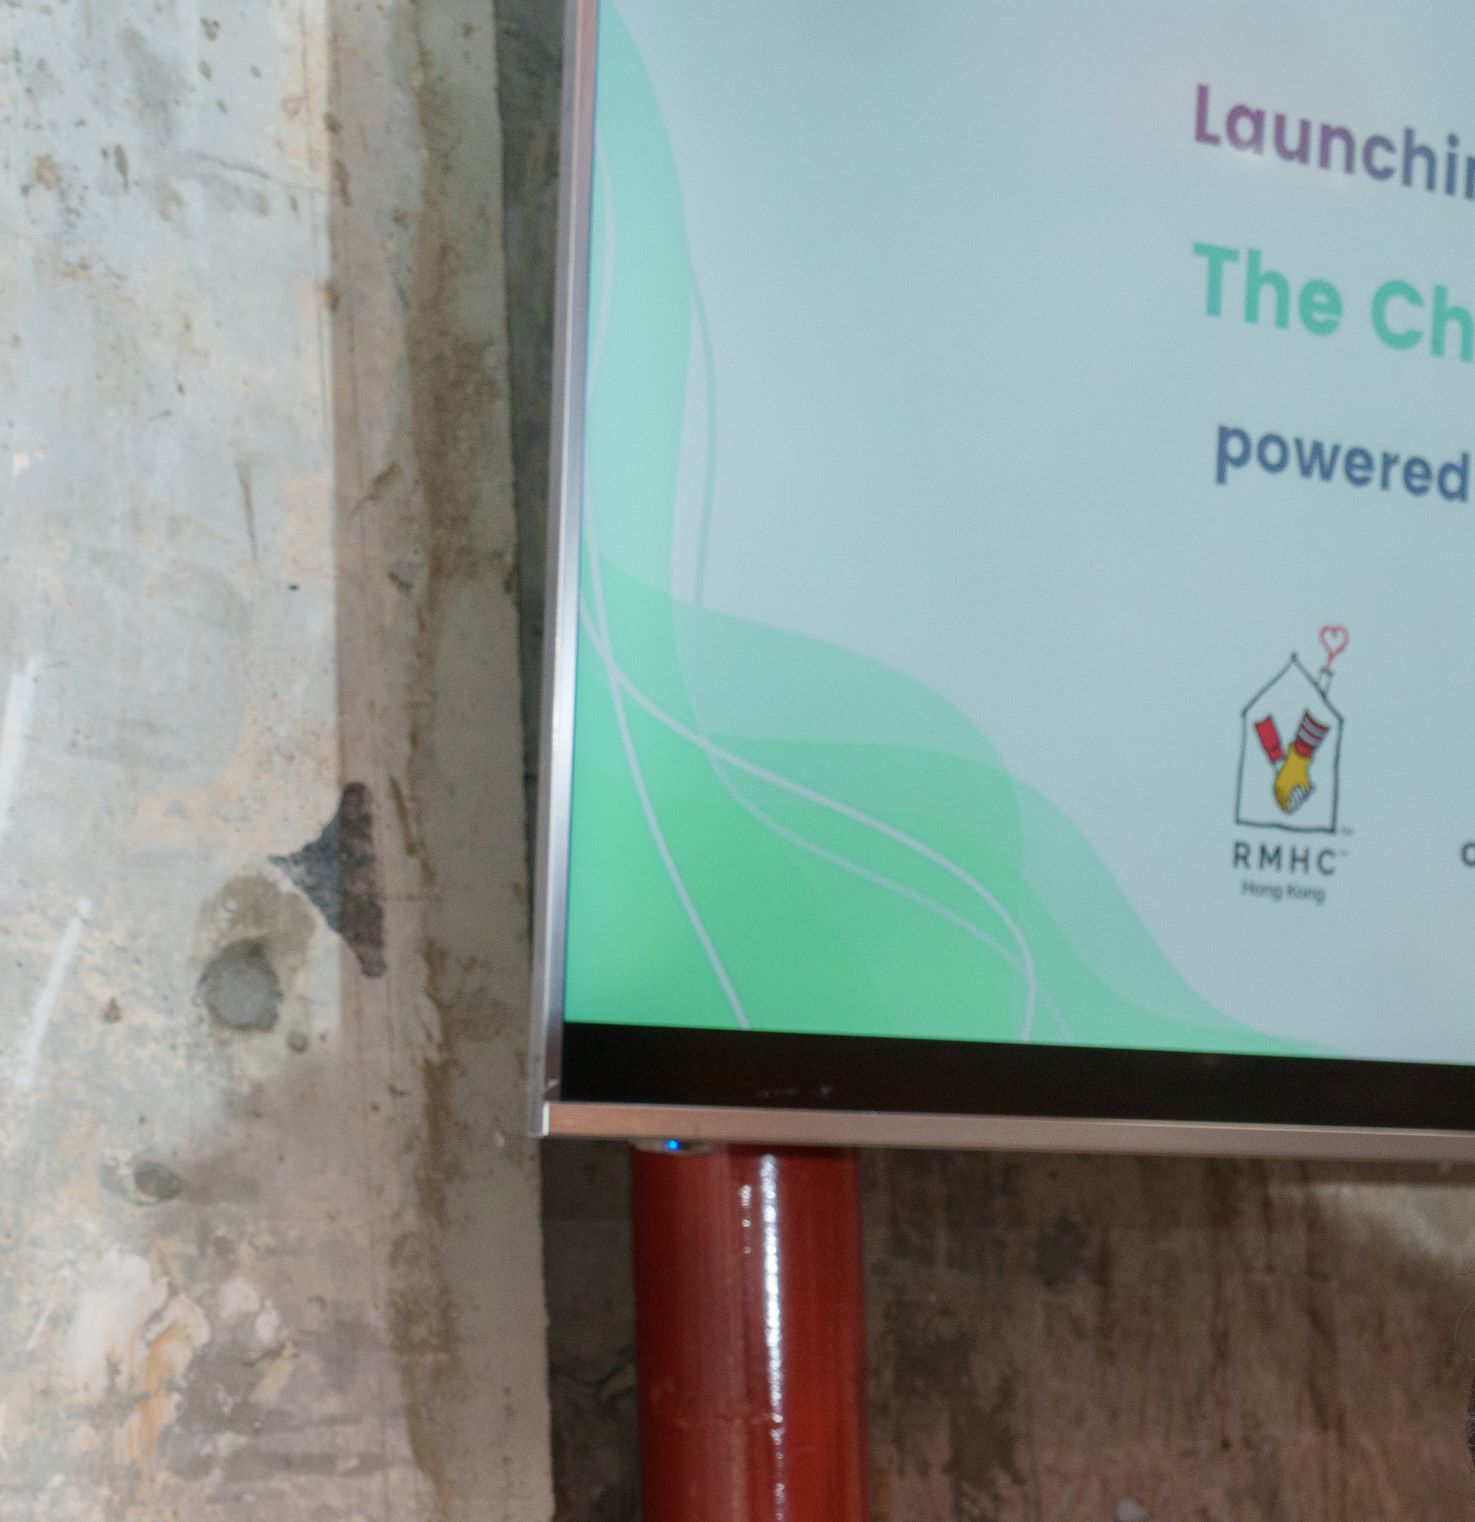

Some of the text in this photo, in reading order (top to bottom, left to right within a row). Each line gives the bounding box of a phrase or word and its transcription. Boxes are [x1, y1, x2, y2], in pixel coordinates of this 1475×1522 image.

[1194, 242, 1343, 338] The
[1215, 424, 1470, 503] powered
[1232, 841, 1337, 877] RMHC
[1241, 880, 1326, 906] Hong Kong
